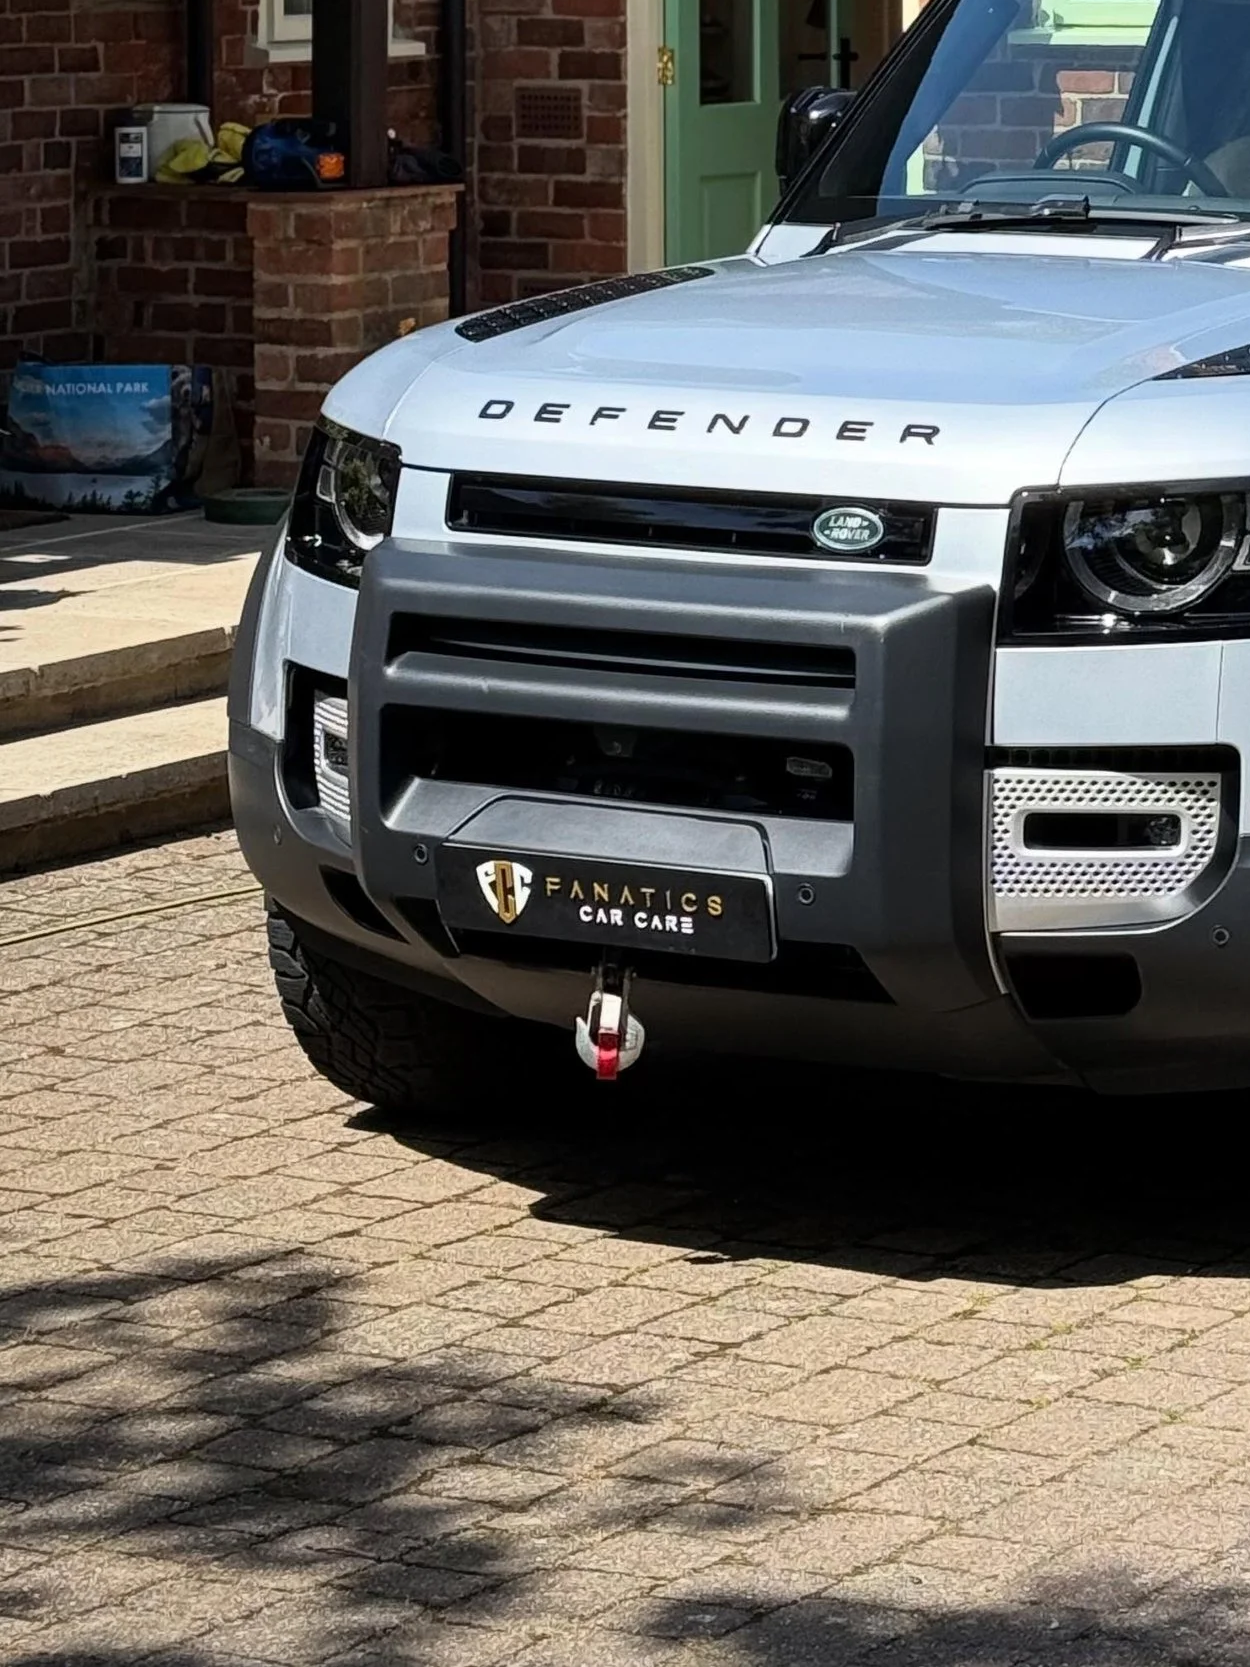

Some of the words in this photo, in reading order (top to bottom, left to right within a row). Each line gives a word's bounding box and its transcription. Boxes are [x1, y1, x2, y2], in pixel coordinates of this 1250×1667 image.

[46, 382, 112, 396] NATIONAL
[116, 382, 149, 394] PARK
[478, 399, 940, 445] DEFENDER
[828, 516, 862, 528] LAND
[830, 528, 870, 540] ROVER
[545, 877, 723, 917] FANATICS
[579, 905, 624, 927] CAR
[634, 911, 695, 935] CARE
